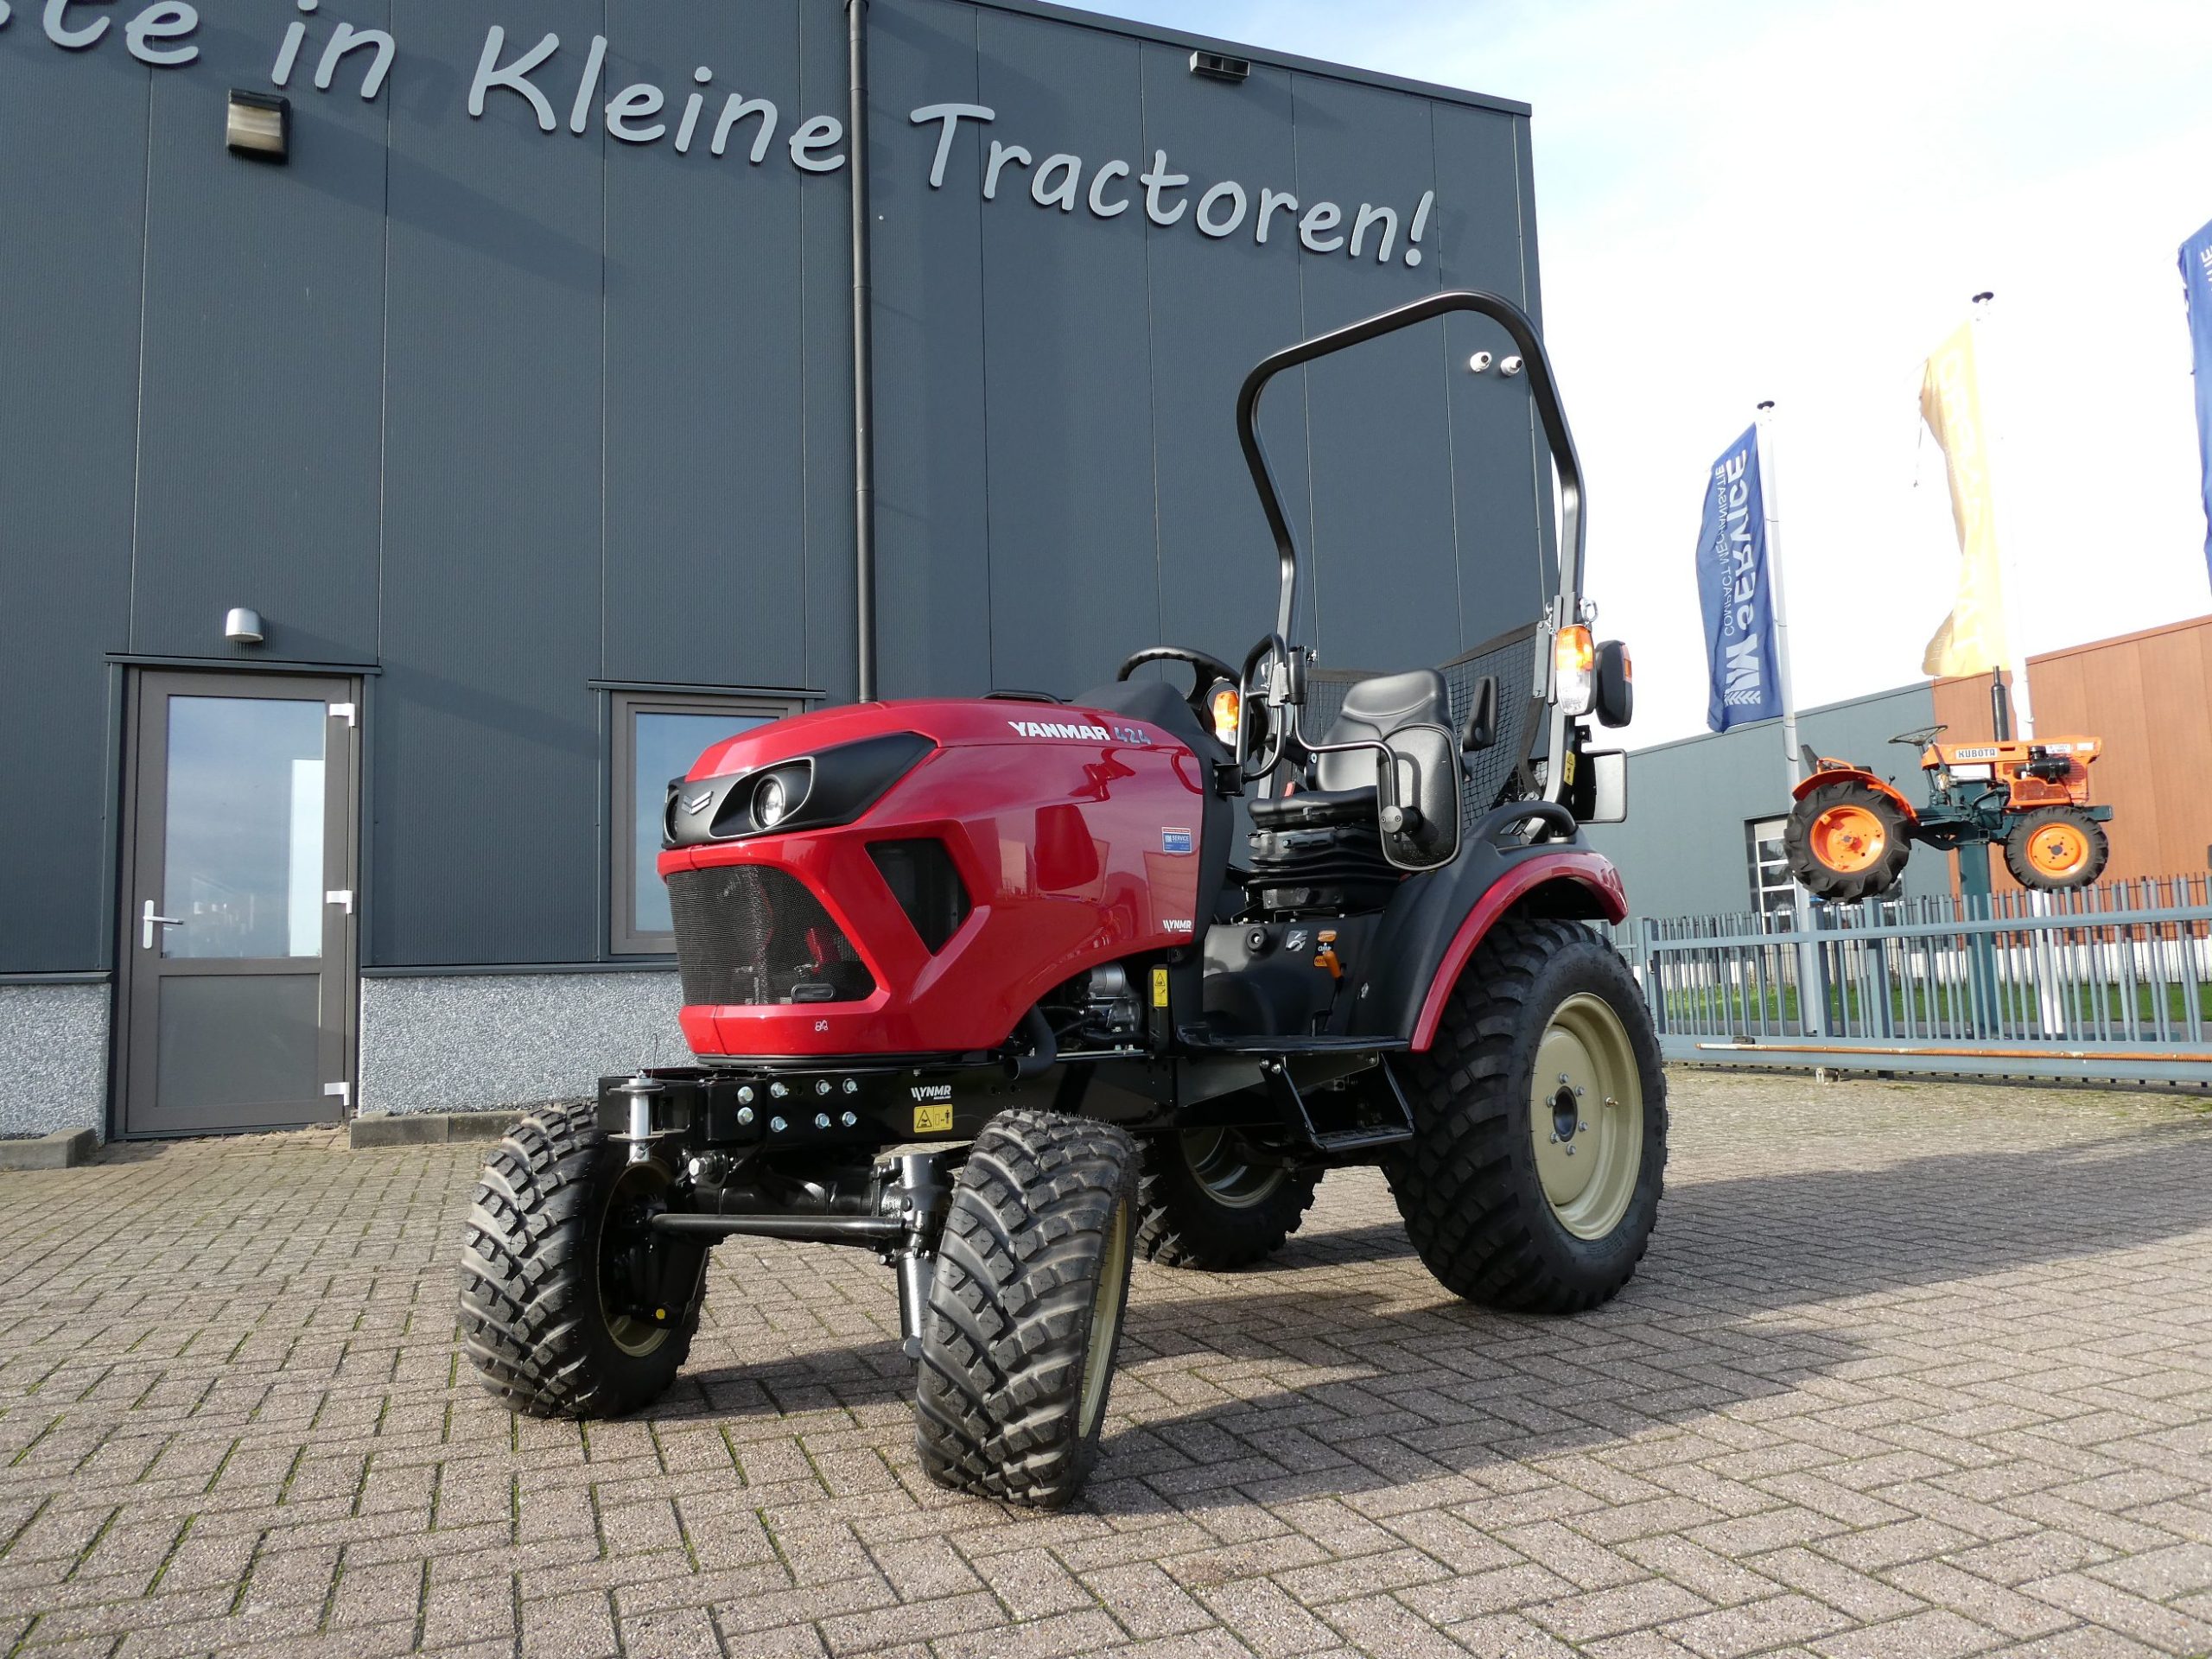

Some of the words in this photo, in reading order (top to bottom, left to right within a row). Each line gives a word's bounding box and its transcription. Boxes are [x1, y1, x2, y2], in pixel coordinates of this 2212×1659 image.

[271, 0, 397, 99] in
[467, 24, 846, 174] Kleine
[909, 103, 1435, 269] Tractoren!
[1007, 721, 1111, 741] YANMAR
[1114, 726, 1152, 746] 424
[1958, 748, 1996, 758] KUBOTA
